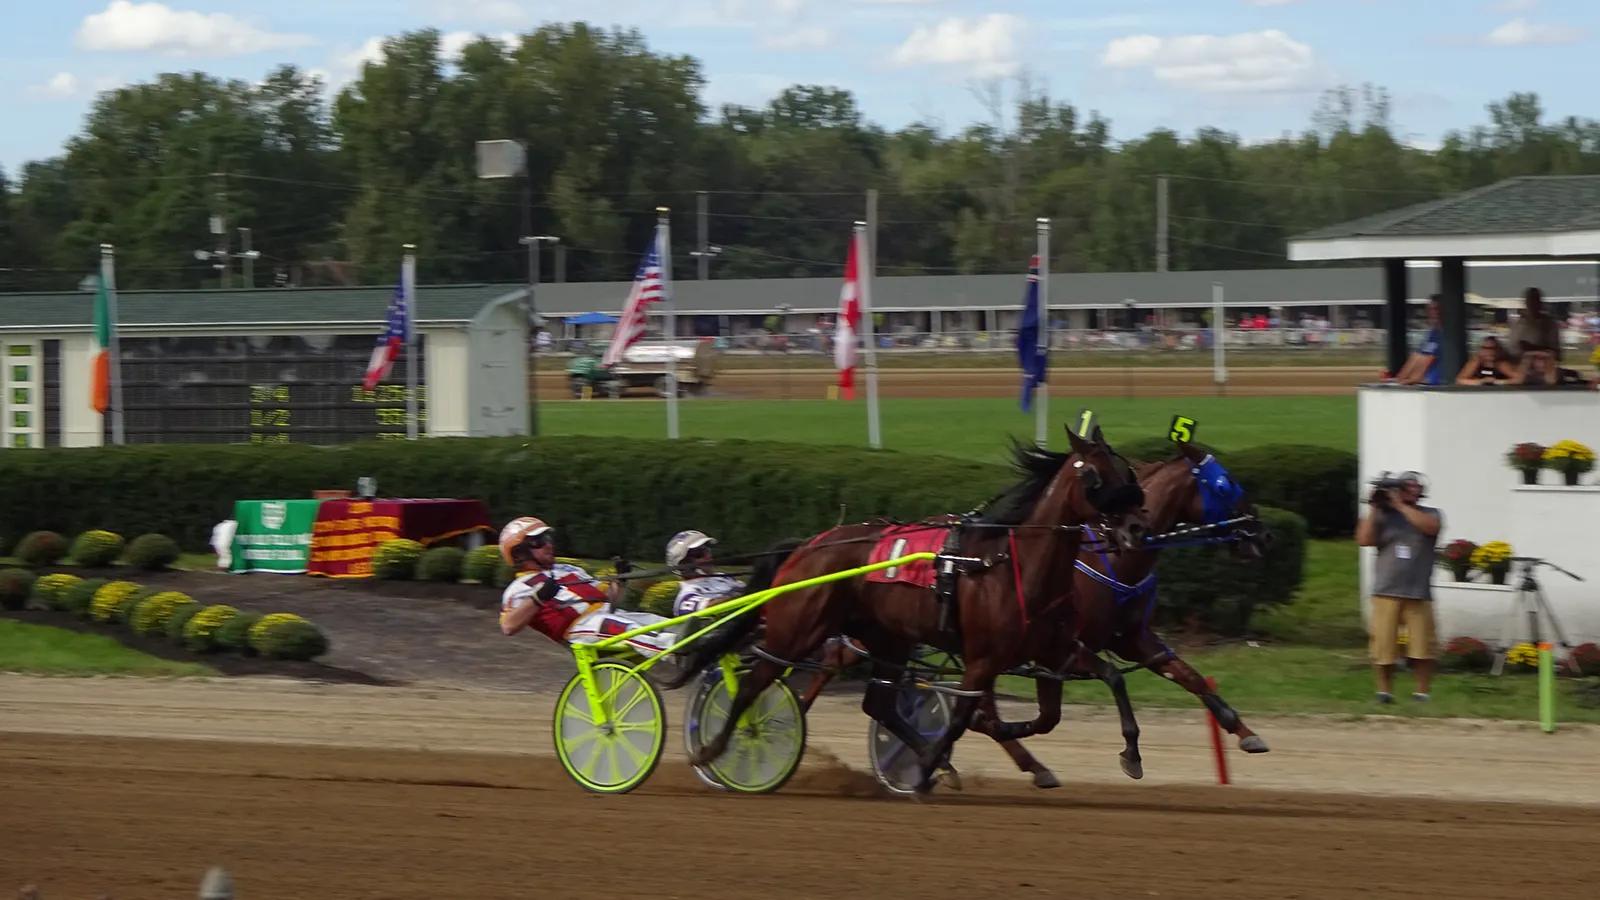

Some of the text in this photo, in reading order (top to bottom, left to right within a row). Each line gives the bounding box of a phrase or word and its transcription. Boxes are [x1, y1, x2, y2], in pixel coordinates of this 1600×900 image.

[1079, 409, 1093, 438] 1
[1170, 416, 1195, 443] 5
[885, 538, 907, 578] 1
